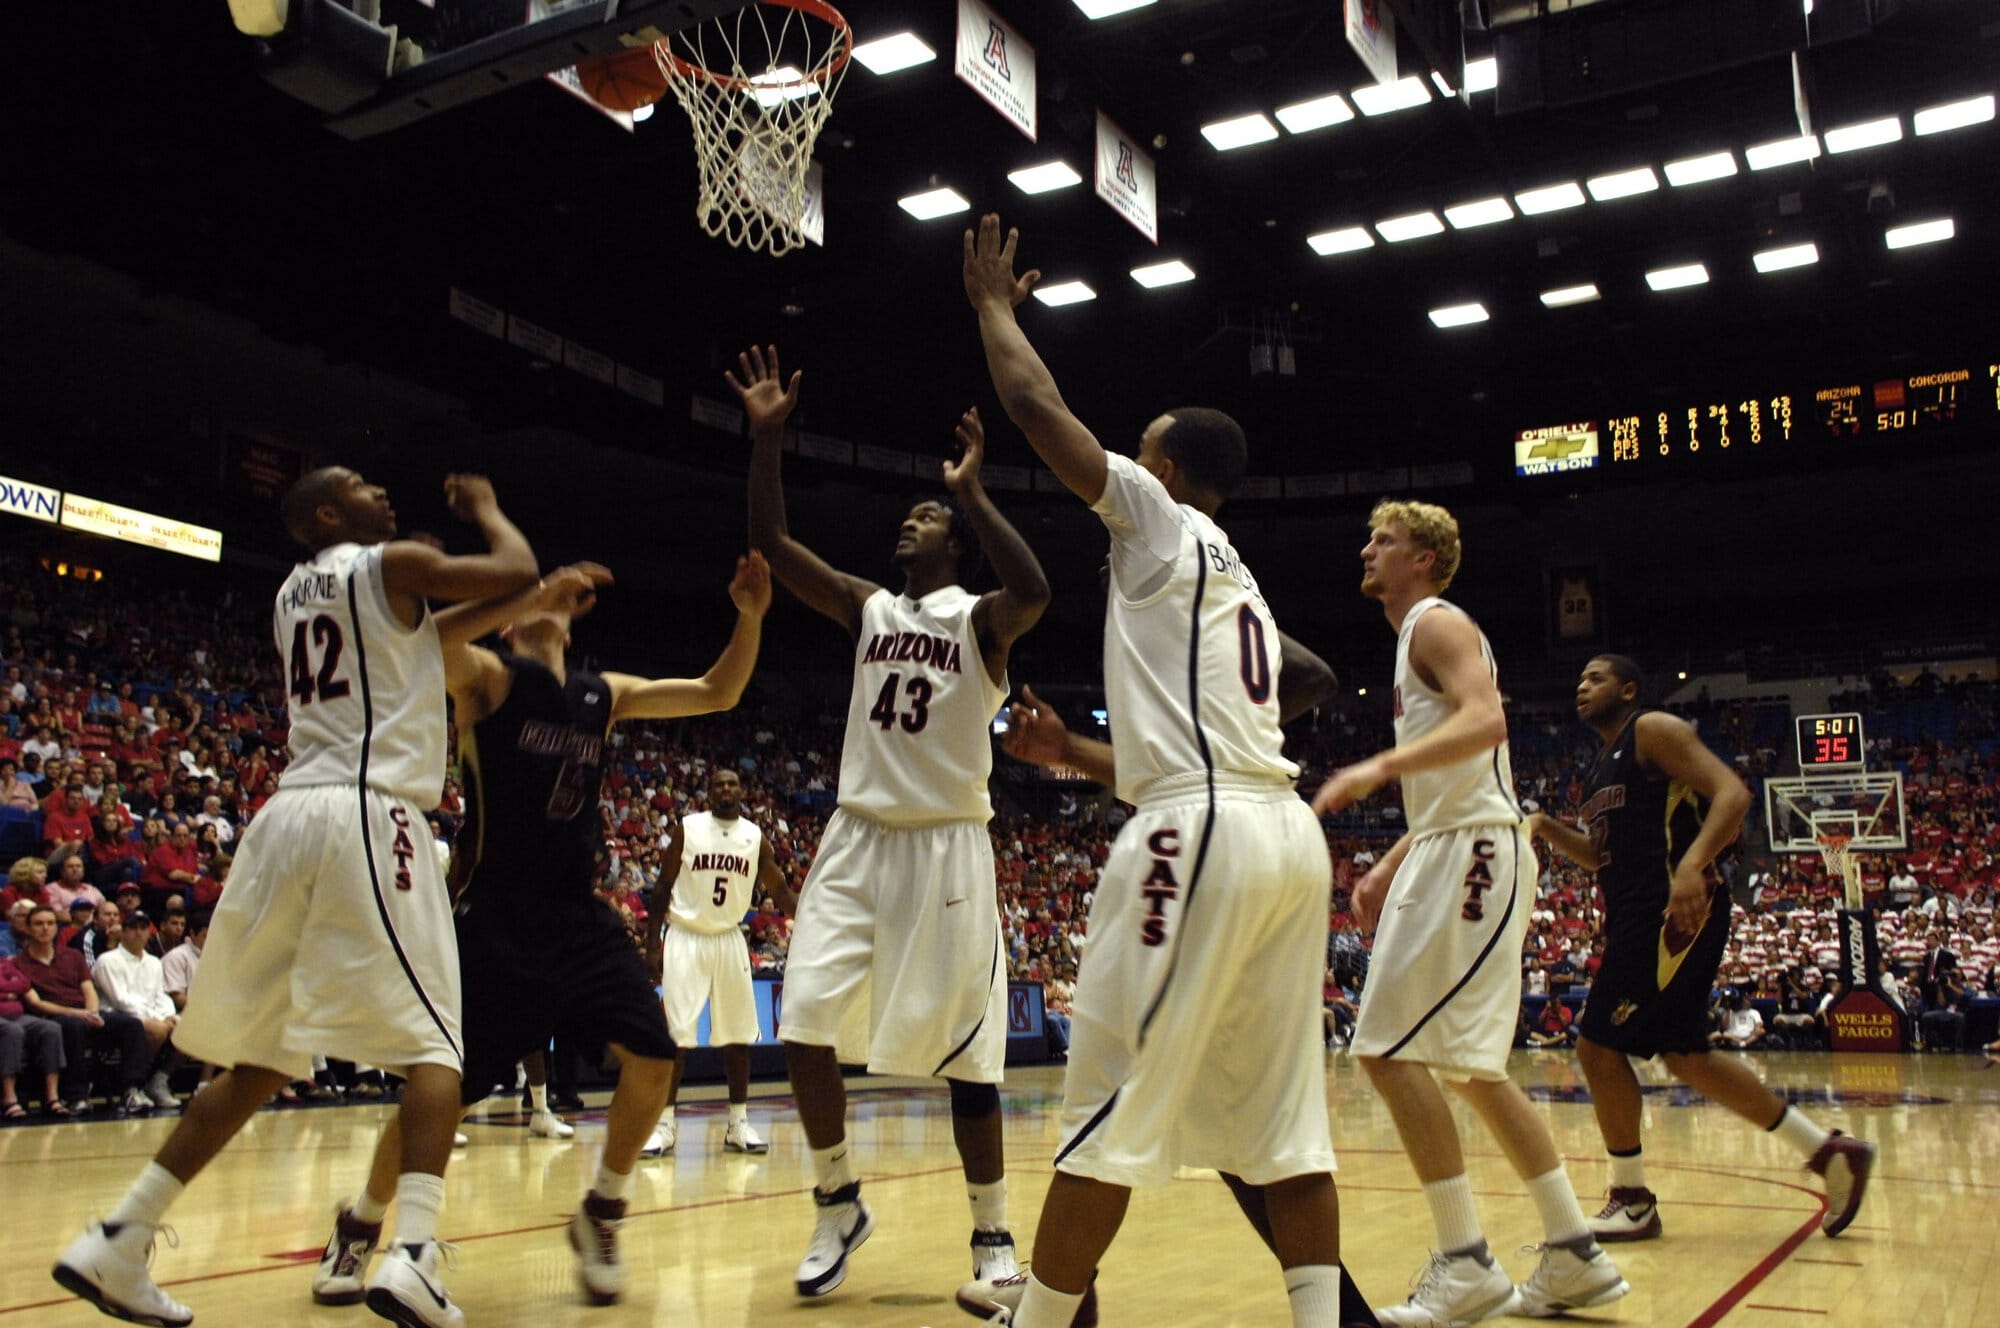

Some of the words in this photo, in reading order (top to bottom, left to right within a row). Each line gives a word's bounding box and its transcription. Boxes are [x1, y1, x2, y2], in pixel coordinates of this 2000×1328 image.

[983, 19, 1010, 82] A
[1909, 369, 1969, 388] CONCORDIA
[1816, 385, 1861, 401] ARIZONA
[1831, 400, 1853, 418] 24
[1877, 409, 1917, 431] 5:01
[1521, 423, 1590, 440] O'RIELLY
[1524, 457, 1593, 475] WATSON
[283, 574, 336, 614] HORNE
[291, 615, 350, 705] 42
[862, 632, 962, 675] ARIZONA
[1238, 602, 1270, 704] 0
[869, 673, 932, 734] 43
[1815, 717, 1854, 736] 5:01
[1815, 736, 1849, 763] 35
[390, 807, 414, 890] CATS
[692, 854, 749, 877] ARIZONA
[712, 877, 728, 907] 5
[1143, 829, 1179, 946] CATS
[1462, 840, 1495, 921] CATS
[1848, 914, 1867, 985] ARIZONA
[1834, 1013, 1893, 1026] WELLS
[1837, 1026, 1893, 1039] FARGO
